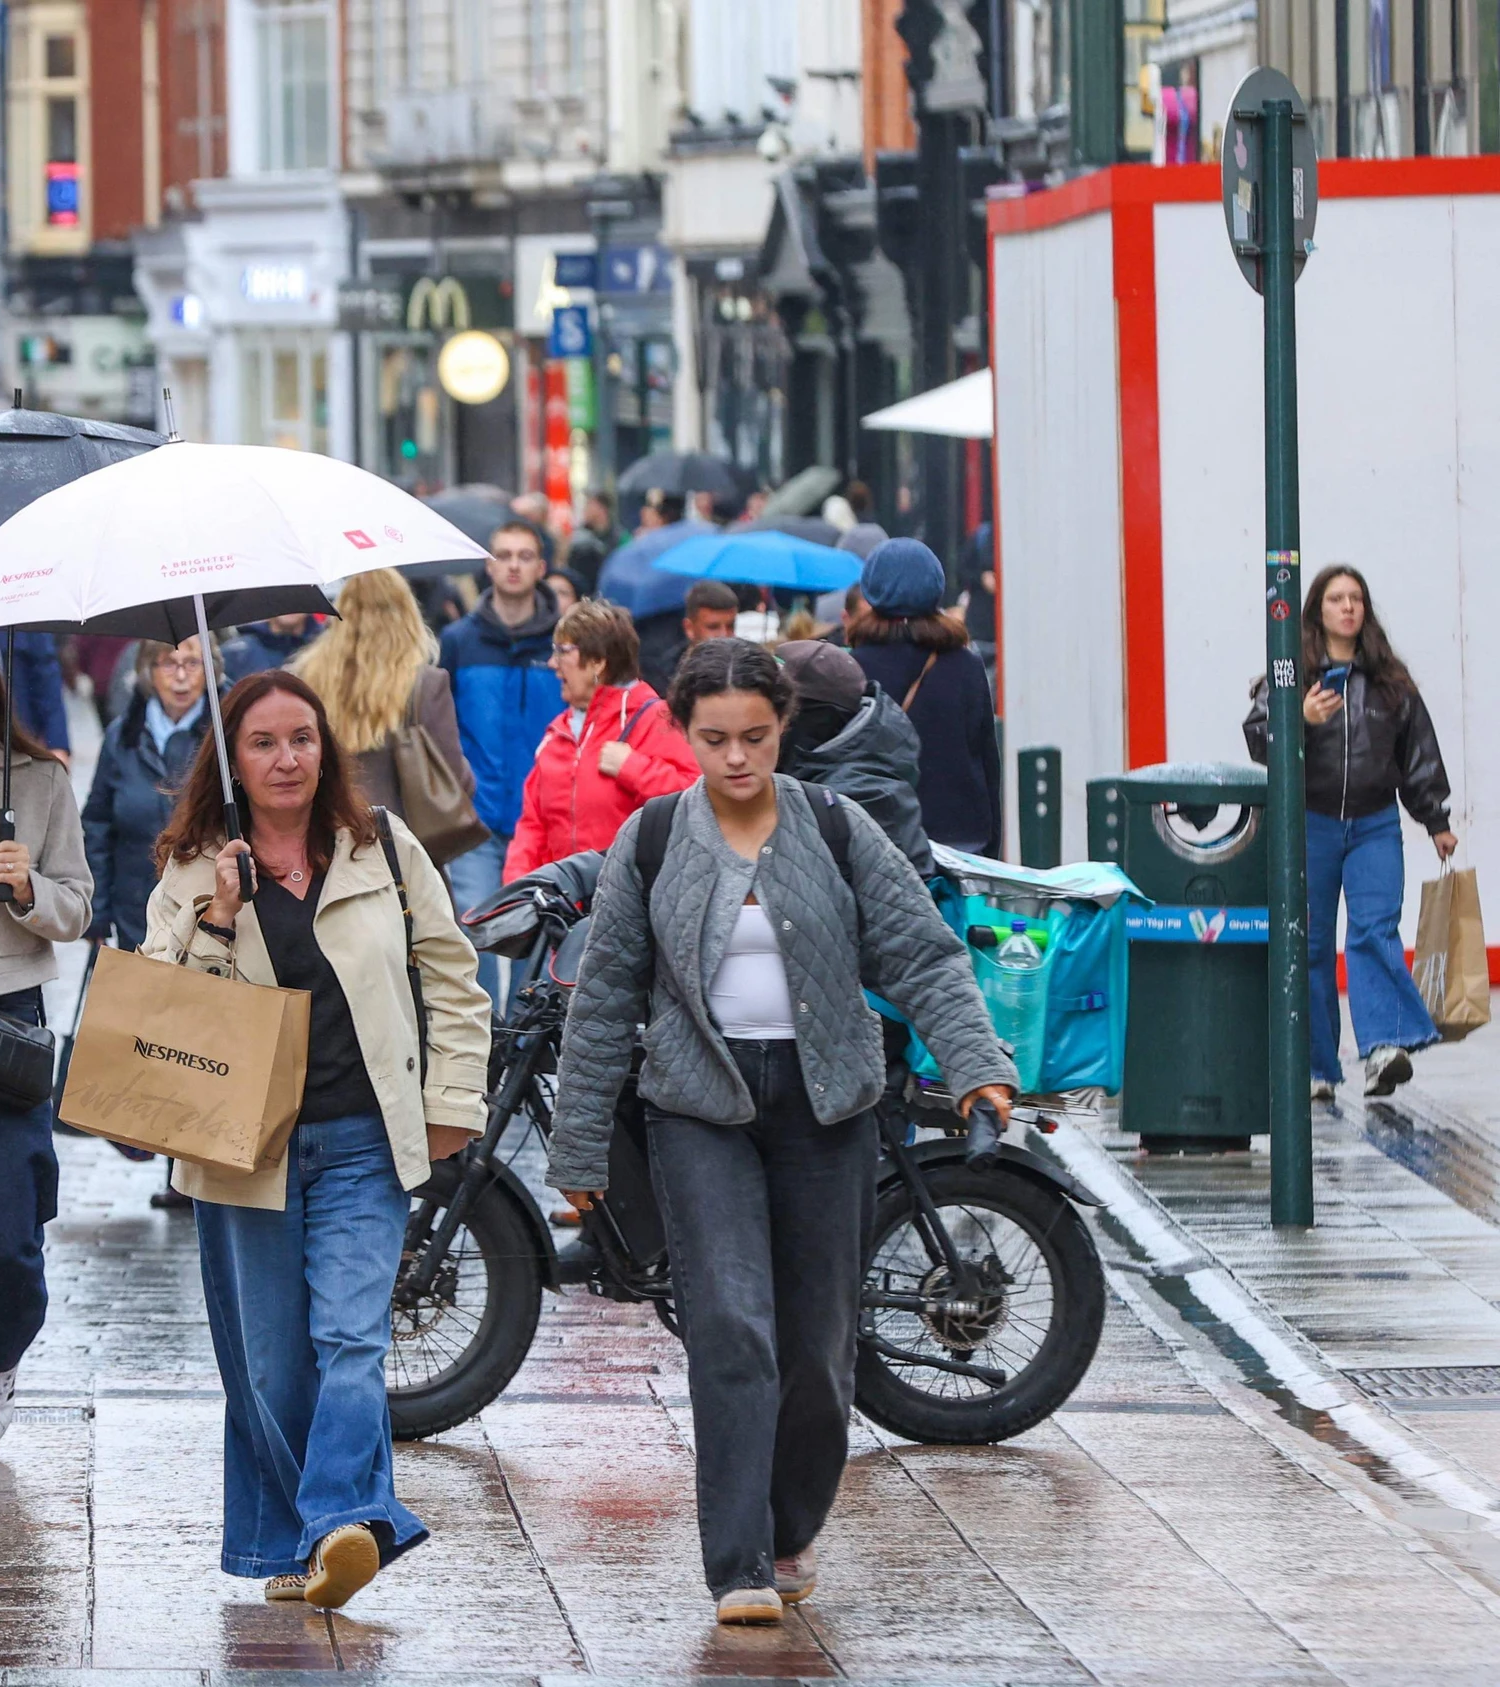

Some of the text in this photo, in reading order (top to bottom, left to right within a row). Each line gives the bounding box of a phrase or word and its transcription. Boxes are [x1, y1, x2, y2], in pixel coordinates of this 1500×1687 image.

[173, 555, 234, 569] BRIGHTER
[0, 567, 54, 585] NESPRESSO
[161, 563, 236, 578] TOMORROW
[132, 1035, 230, 1077] NESPRESSO
